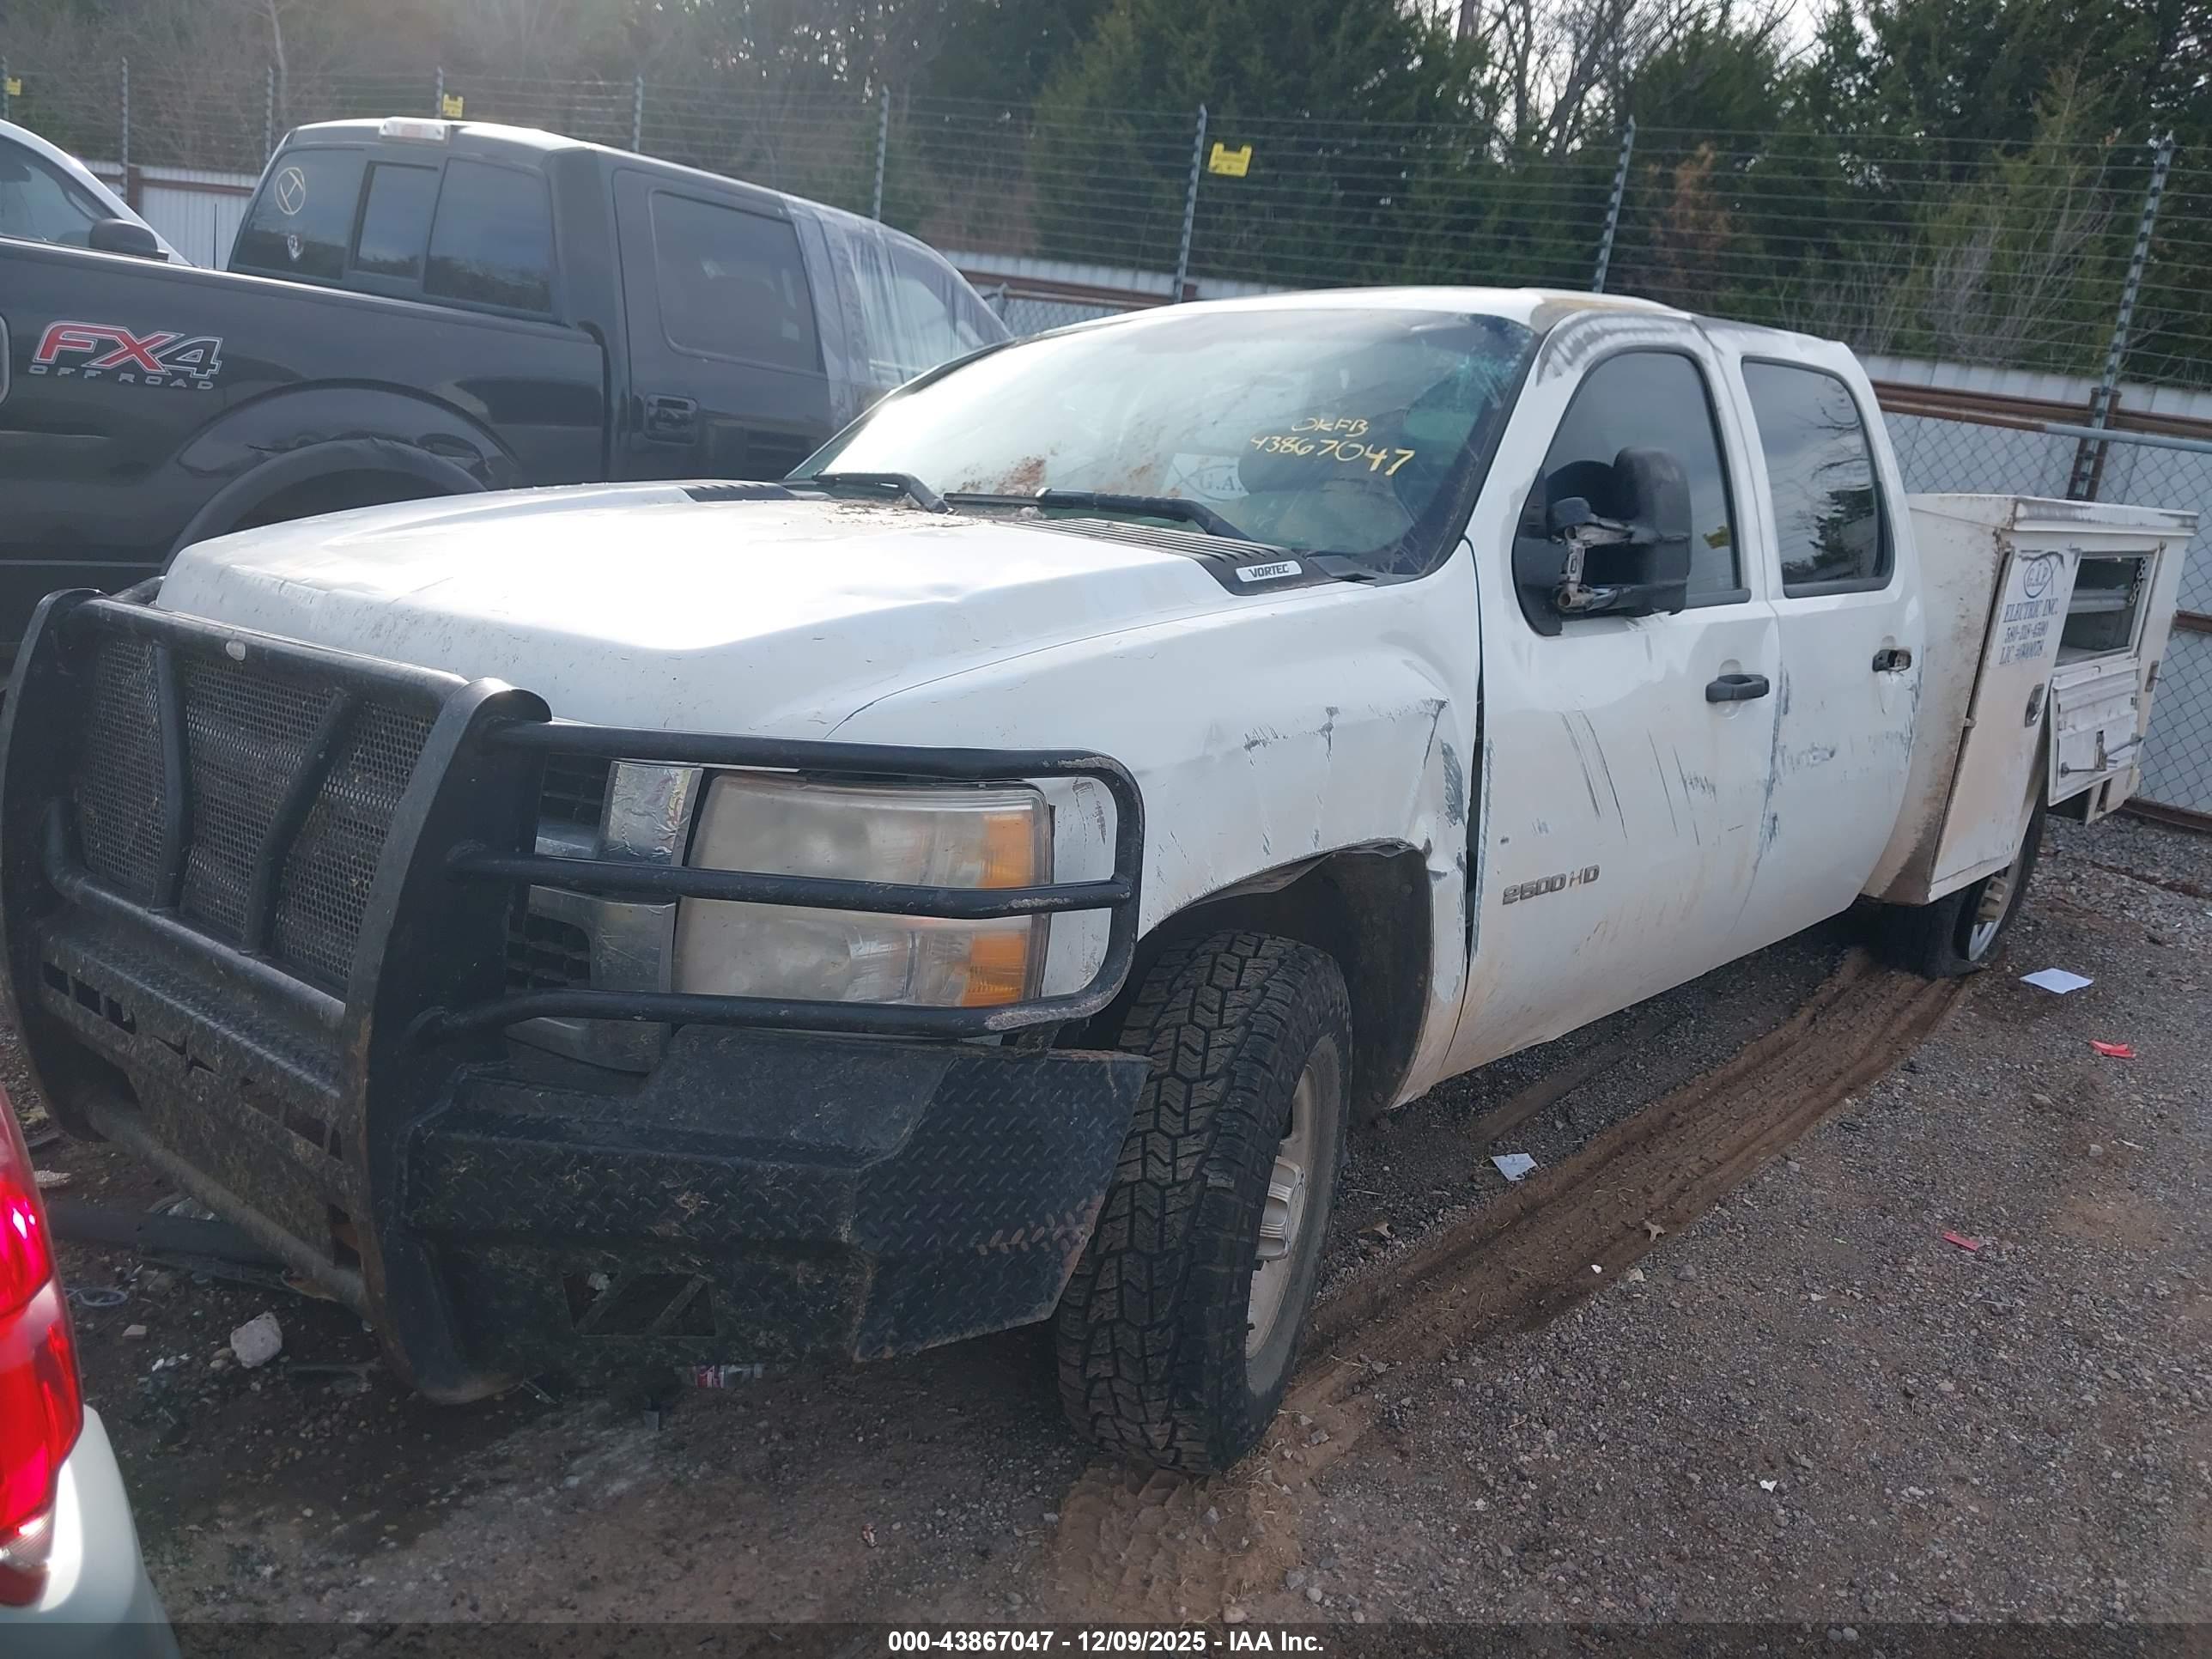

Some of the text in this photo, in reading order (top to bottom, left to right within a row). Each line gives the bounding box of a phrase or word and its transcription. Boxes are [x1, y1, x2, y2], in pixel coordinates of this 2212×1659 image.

[33, 320, 222, 379] FX4
[28, 364, 214, 391] OFF ROAD
[1250, 435, 1416, 476] 43867047
[1249, 563, 1290, 578] VORTEC
[2002, 599, 2043, 623] ELECTRIC
